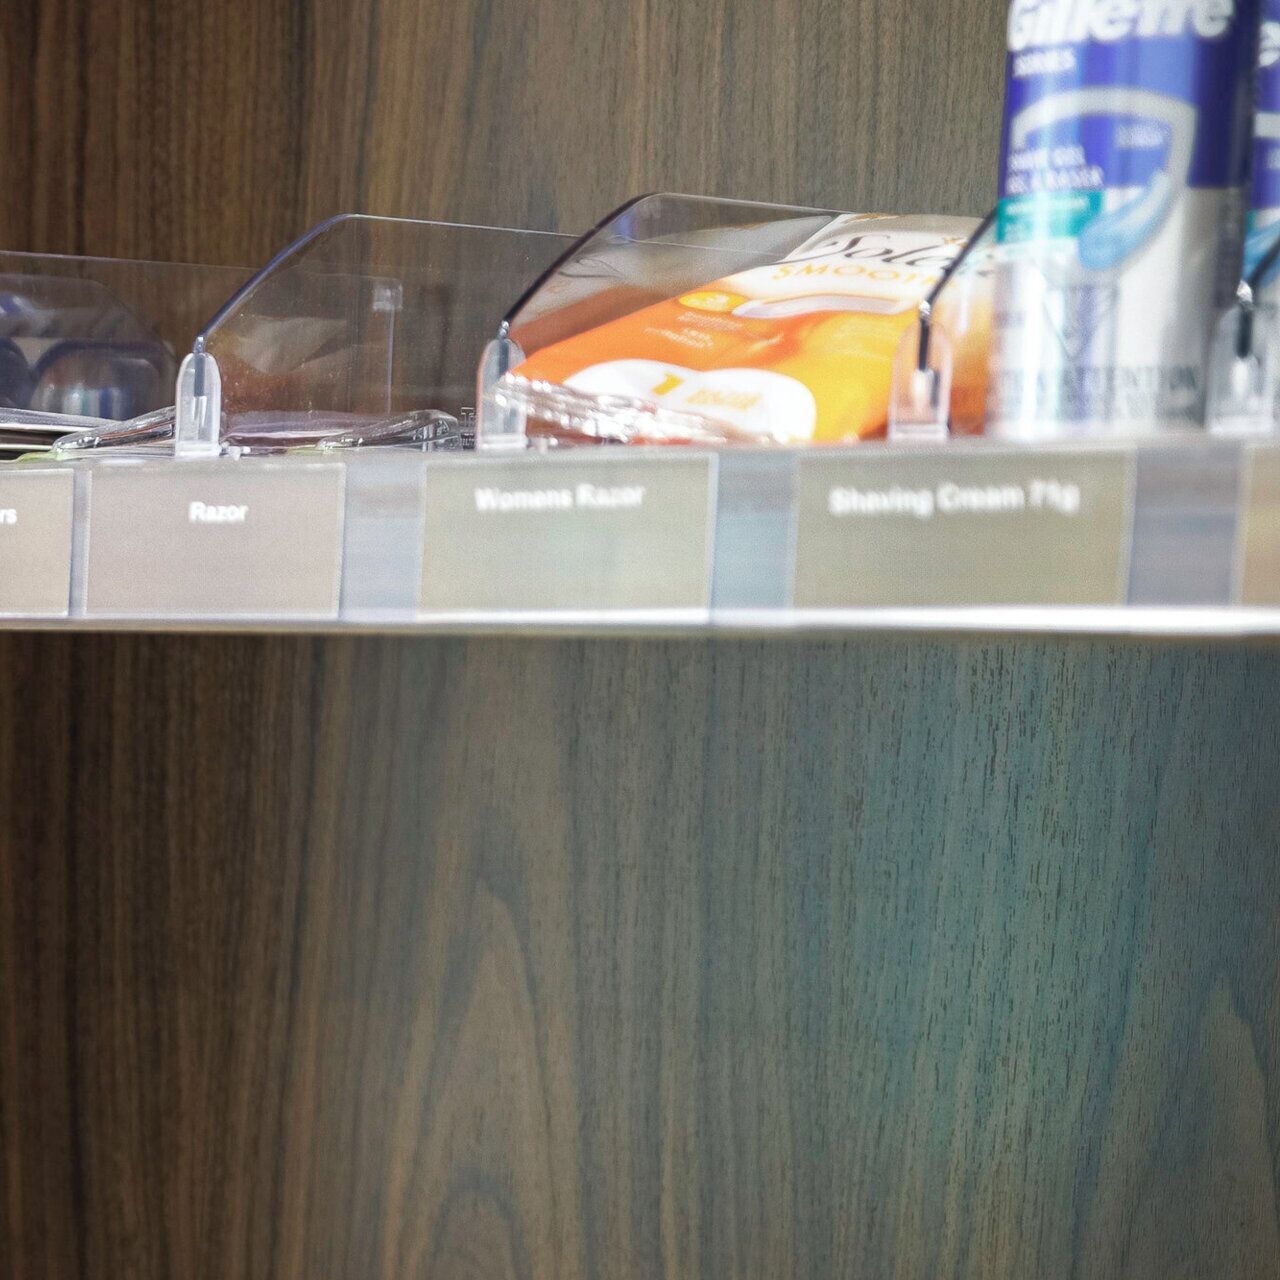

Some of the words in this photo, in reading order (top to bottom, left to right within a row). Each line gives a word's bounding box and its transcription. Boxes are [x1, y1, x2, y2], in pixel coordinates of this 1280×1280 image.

[188, 501, 250, 523] Razor
[474, 486, 573, 512] Womens
[828, 486, 935, 519] Shaving
